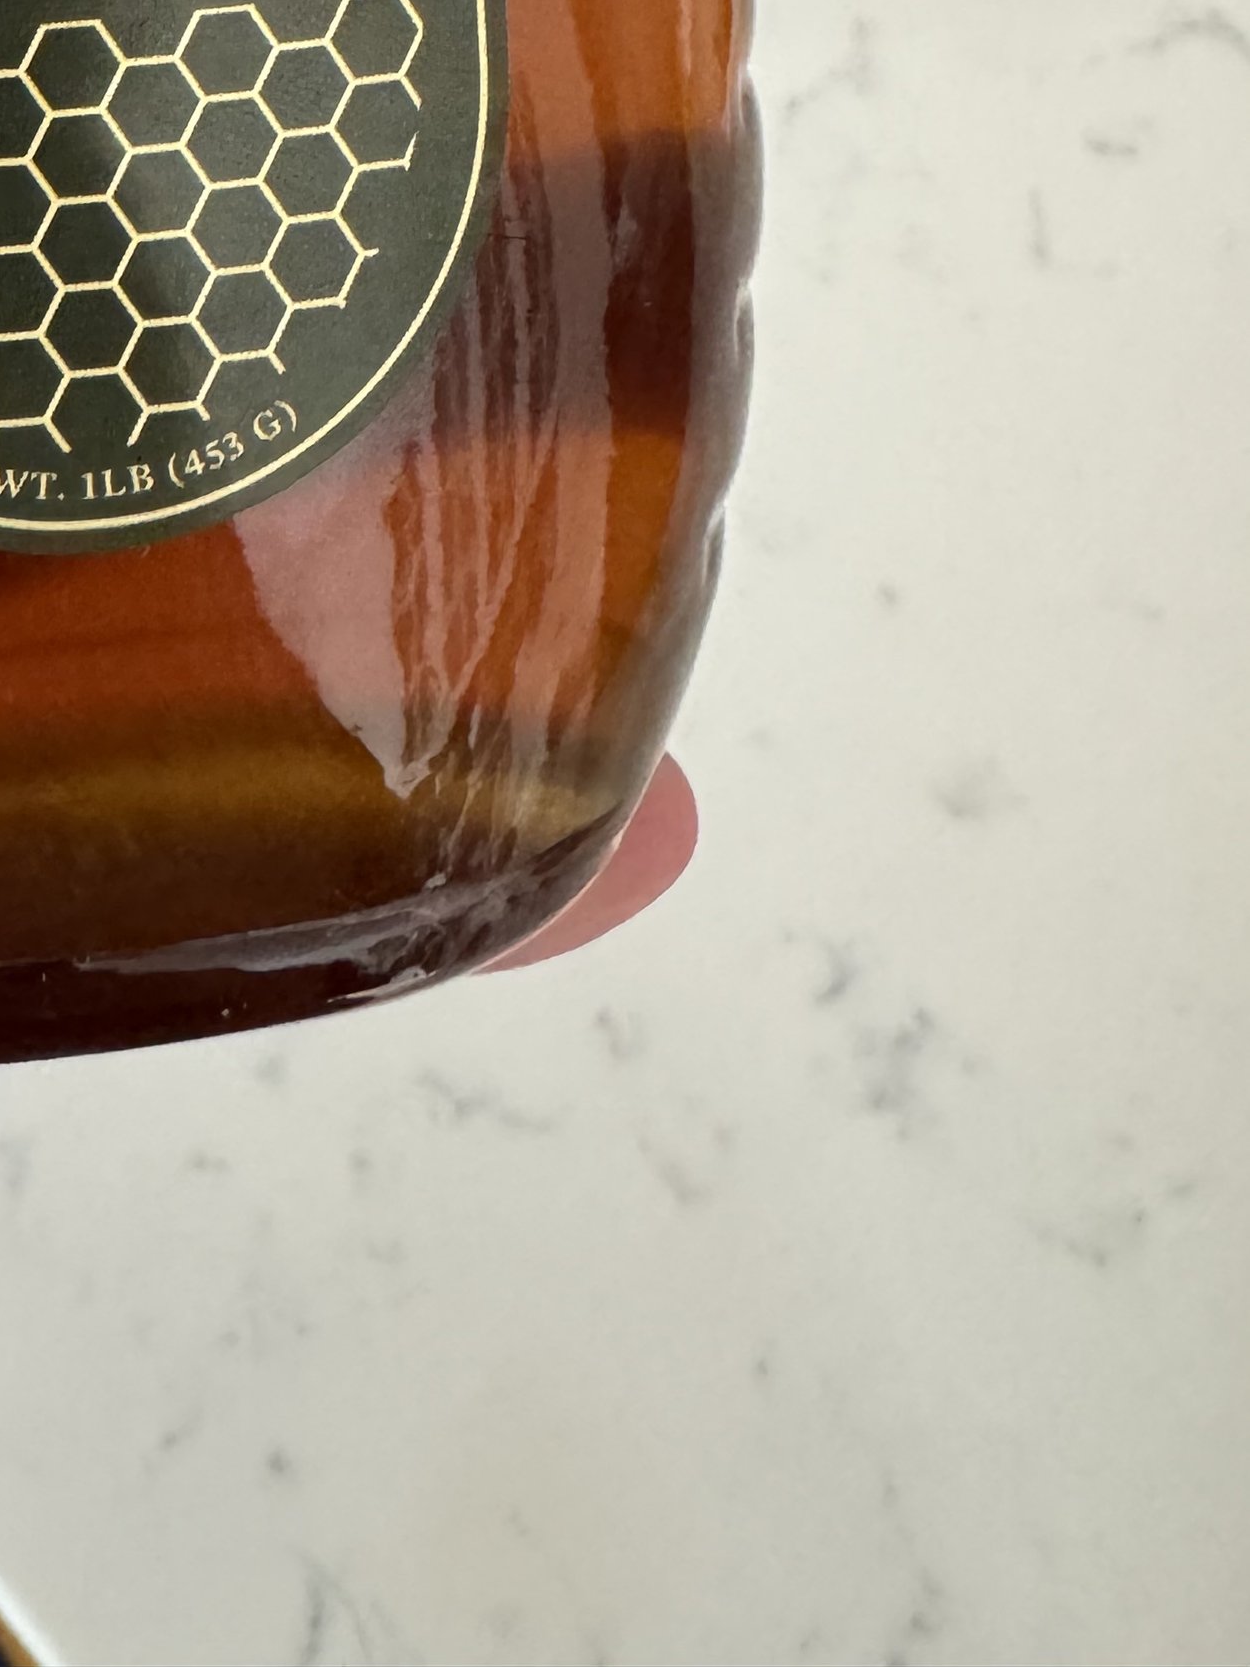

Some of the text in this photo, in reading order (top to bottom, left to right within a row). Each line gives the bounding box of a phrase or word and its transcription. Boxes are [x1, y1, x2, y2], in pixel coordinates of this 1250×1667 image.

[80, 461, 155, 501] 1LB
[167, 430, 247, 490] (453
[252, 399, 298, 441] G)
